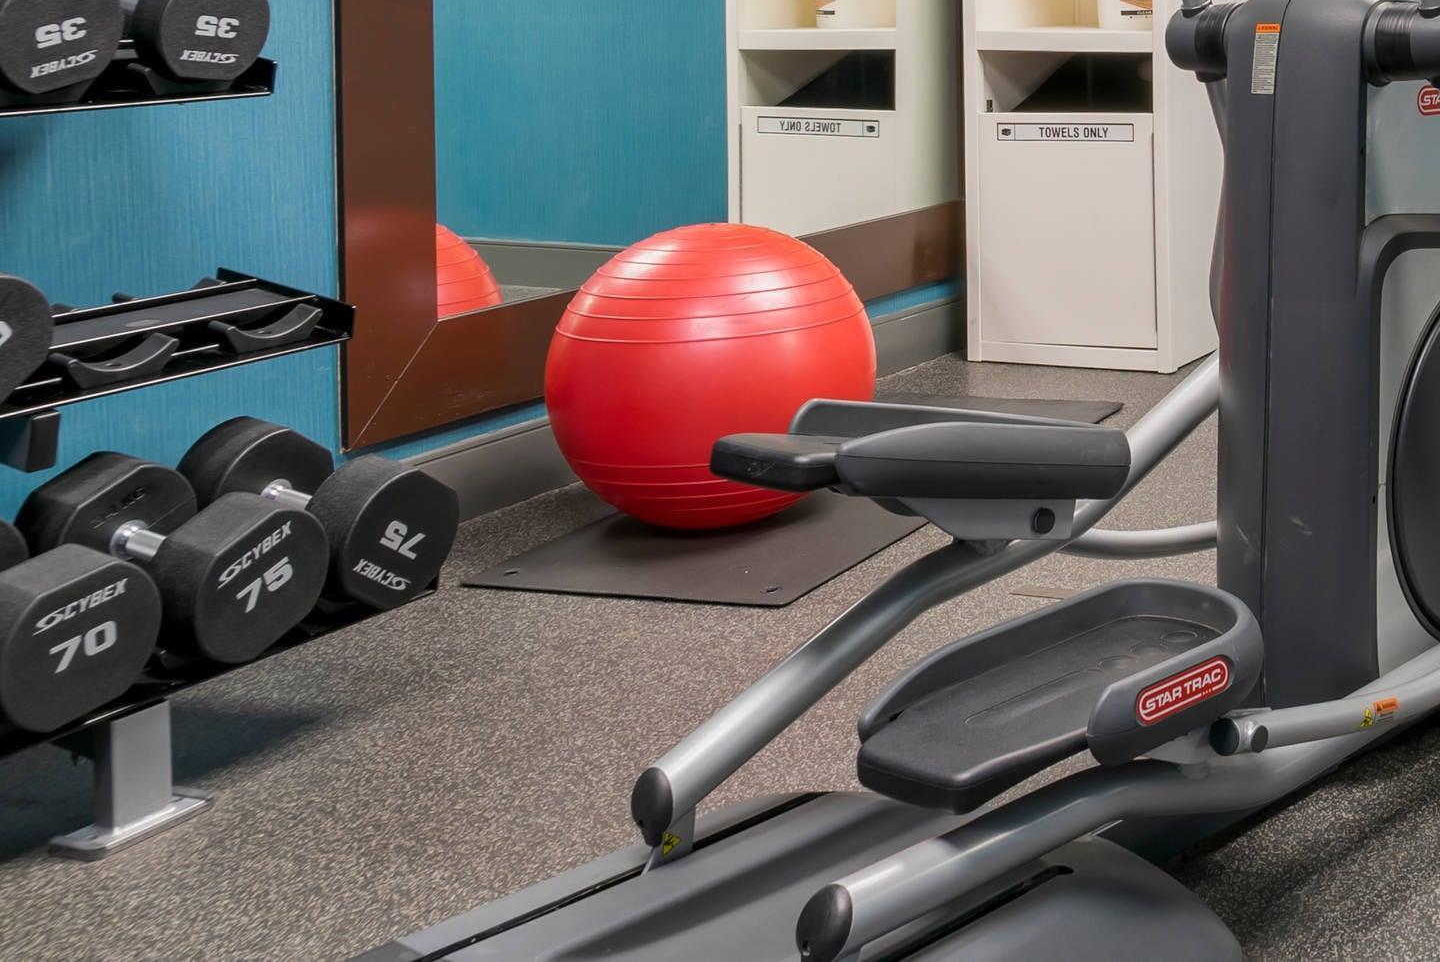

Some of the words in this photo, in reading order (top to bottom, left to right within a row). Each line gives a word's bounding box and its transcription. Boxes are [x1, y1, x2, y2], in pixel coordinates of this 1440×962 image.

[35, 17, 87, 49] 35
[194, 15, 240, 39] 35
[1038, 126, 1080, 139] TOWELS
[1083, 126, 1109, 138] ONLY
[379, 520, 426, 560] 75
[236, 556, 293, 614] 75
[49, 621, 117, 674] 70
[1143, 685, 1183, 714] STAR
[1184, 668, 1222, 695] TRAC
